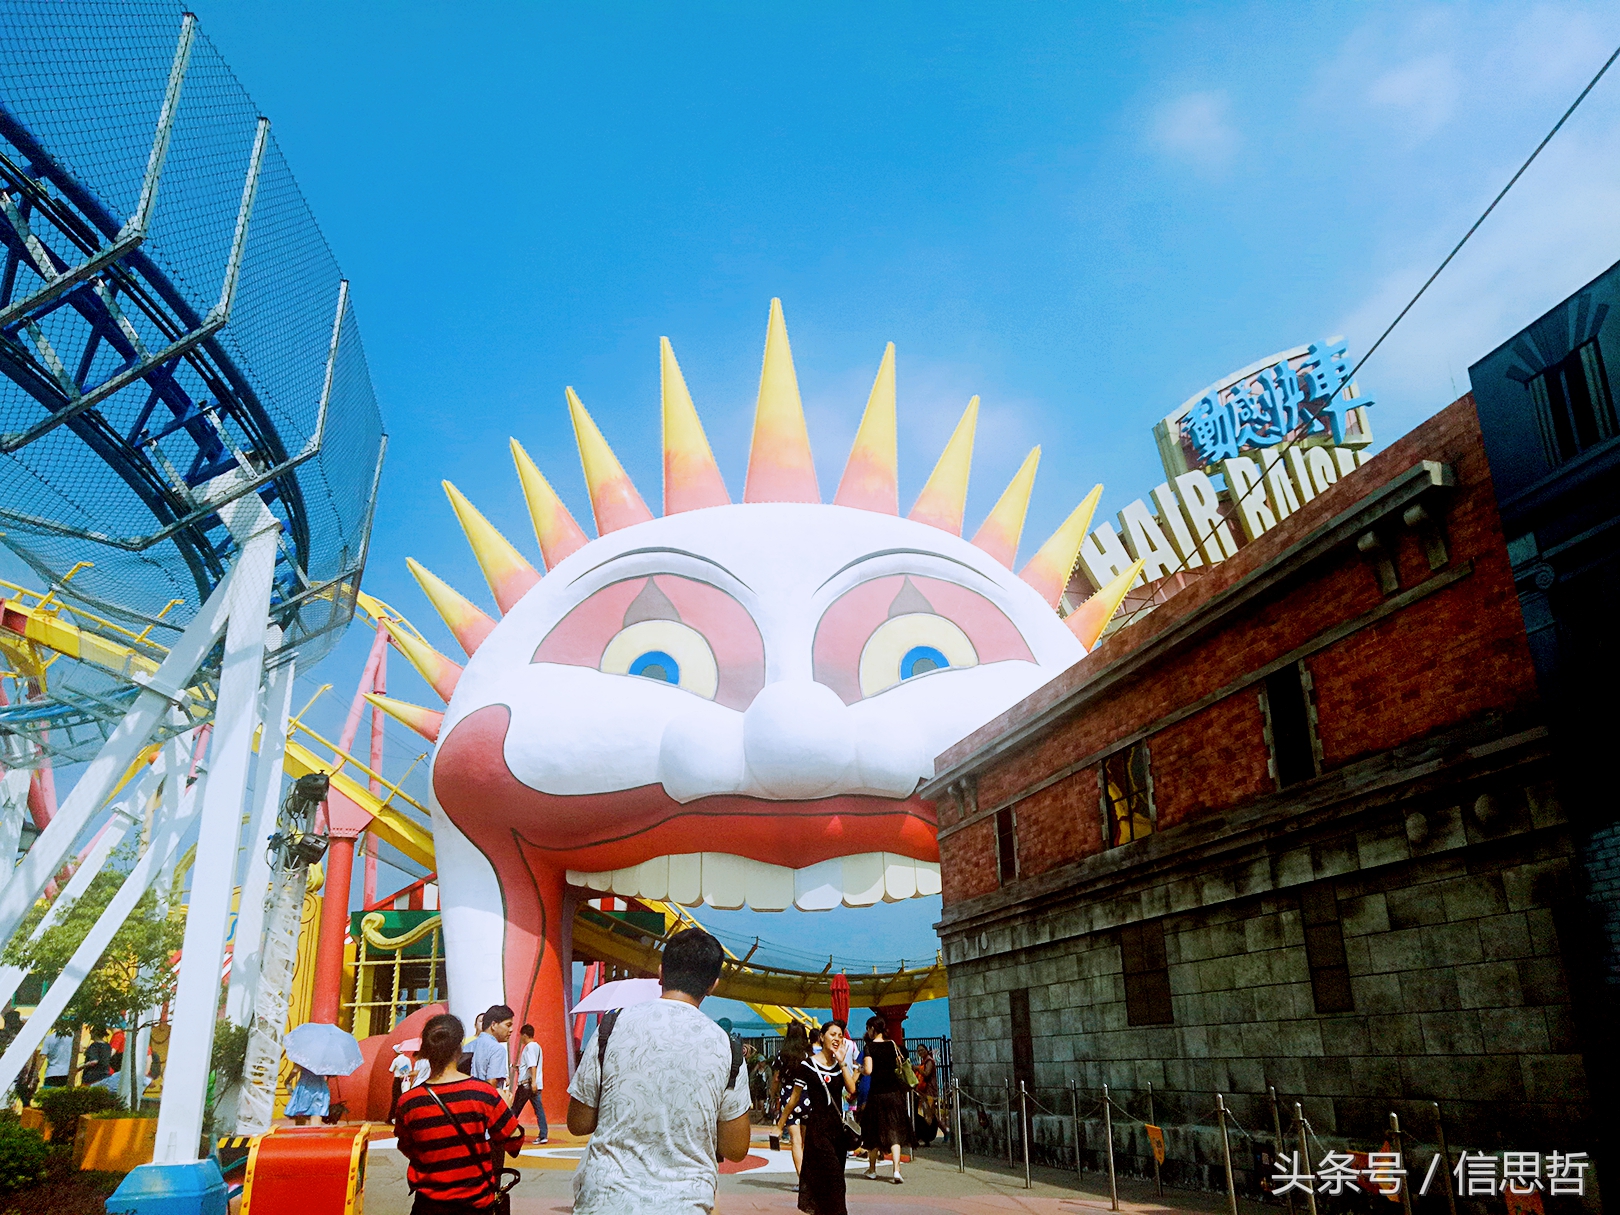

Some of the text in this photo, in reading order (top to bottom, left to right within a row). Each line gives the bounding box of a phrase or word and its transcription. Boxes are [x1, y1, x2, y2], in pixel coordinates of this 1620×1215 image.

[1182, 339, 1375, 464] 動感快車
[1079, 469, 1239, 588] HAIR
